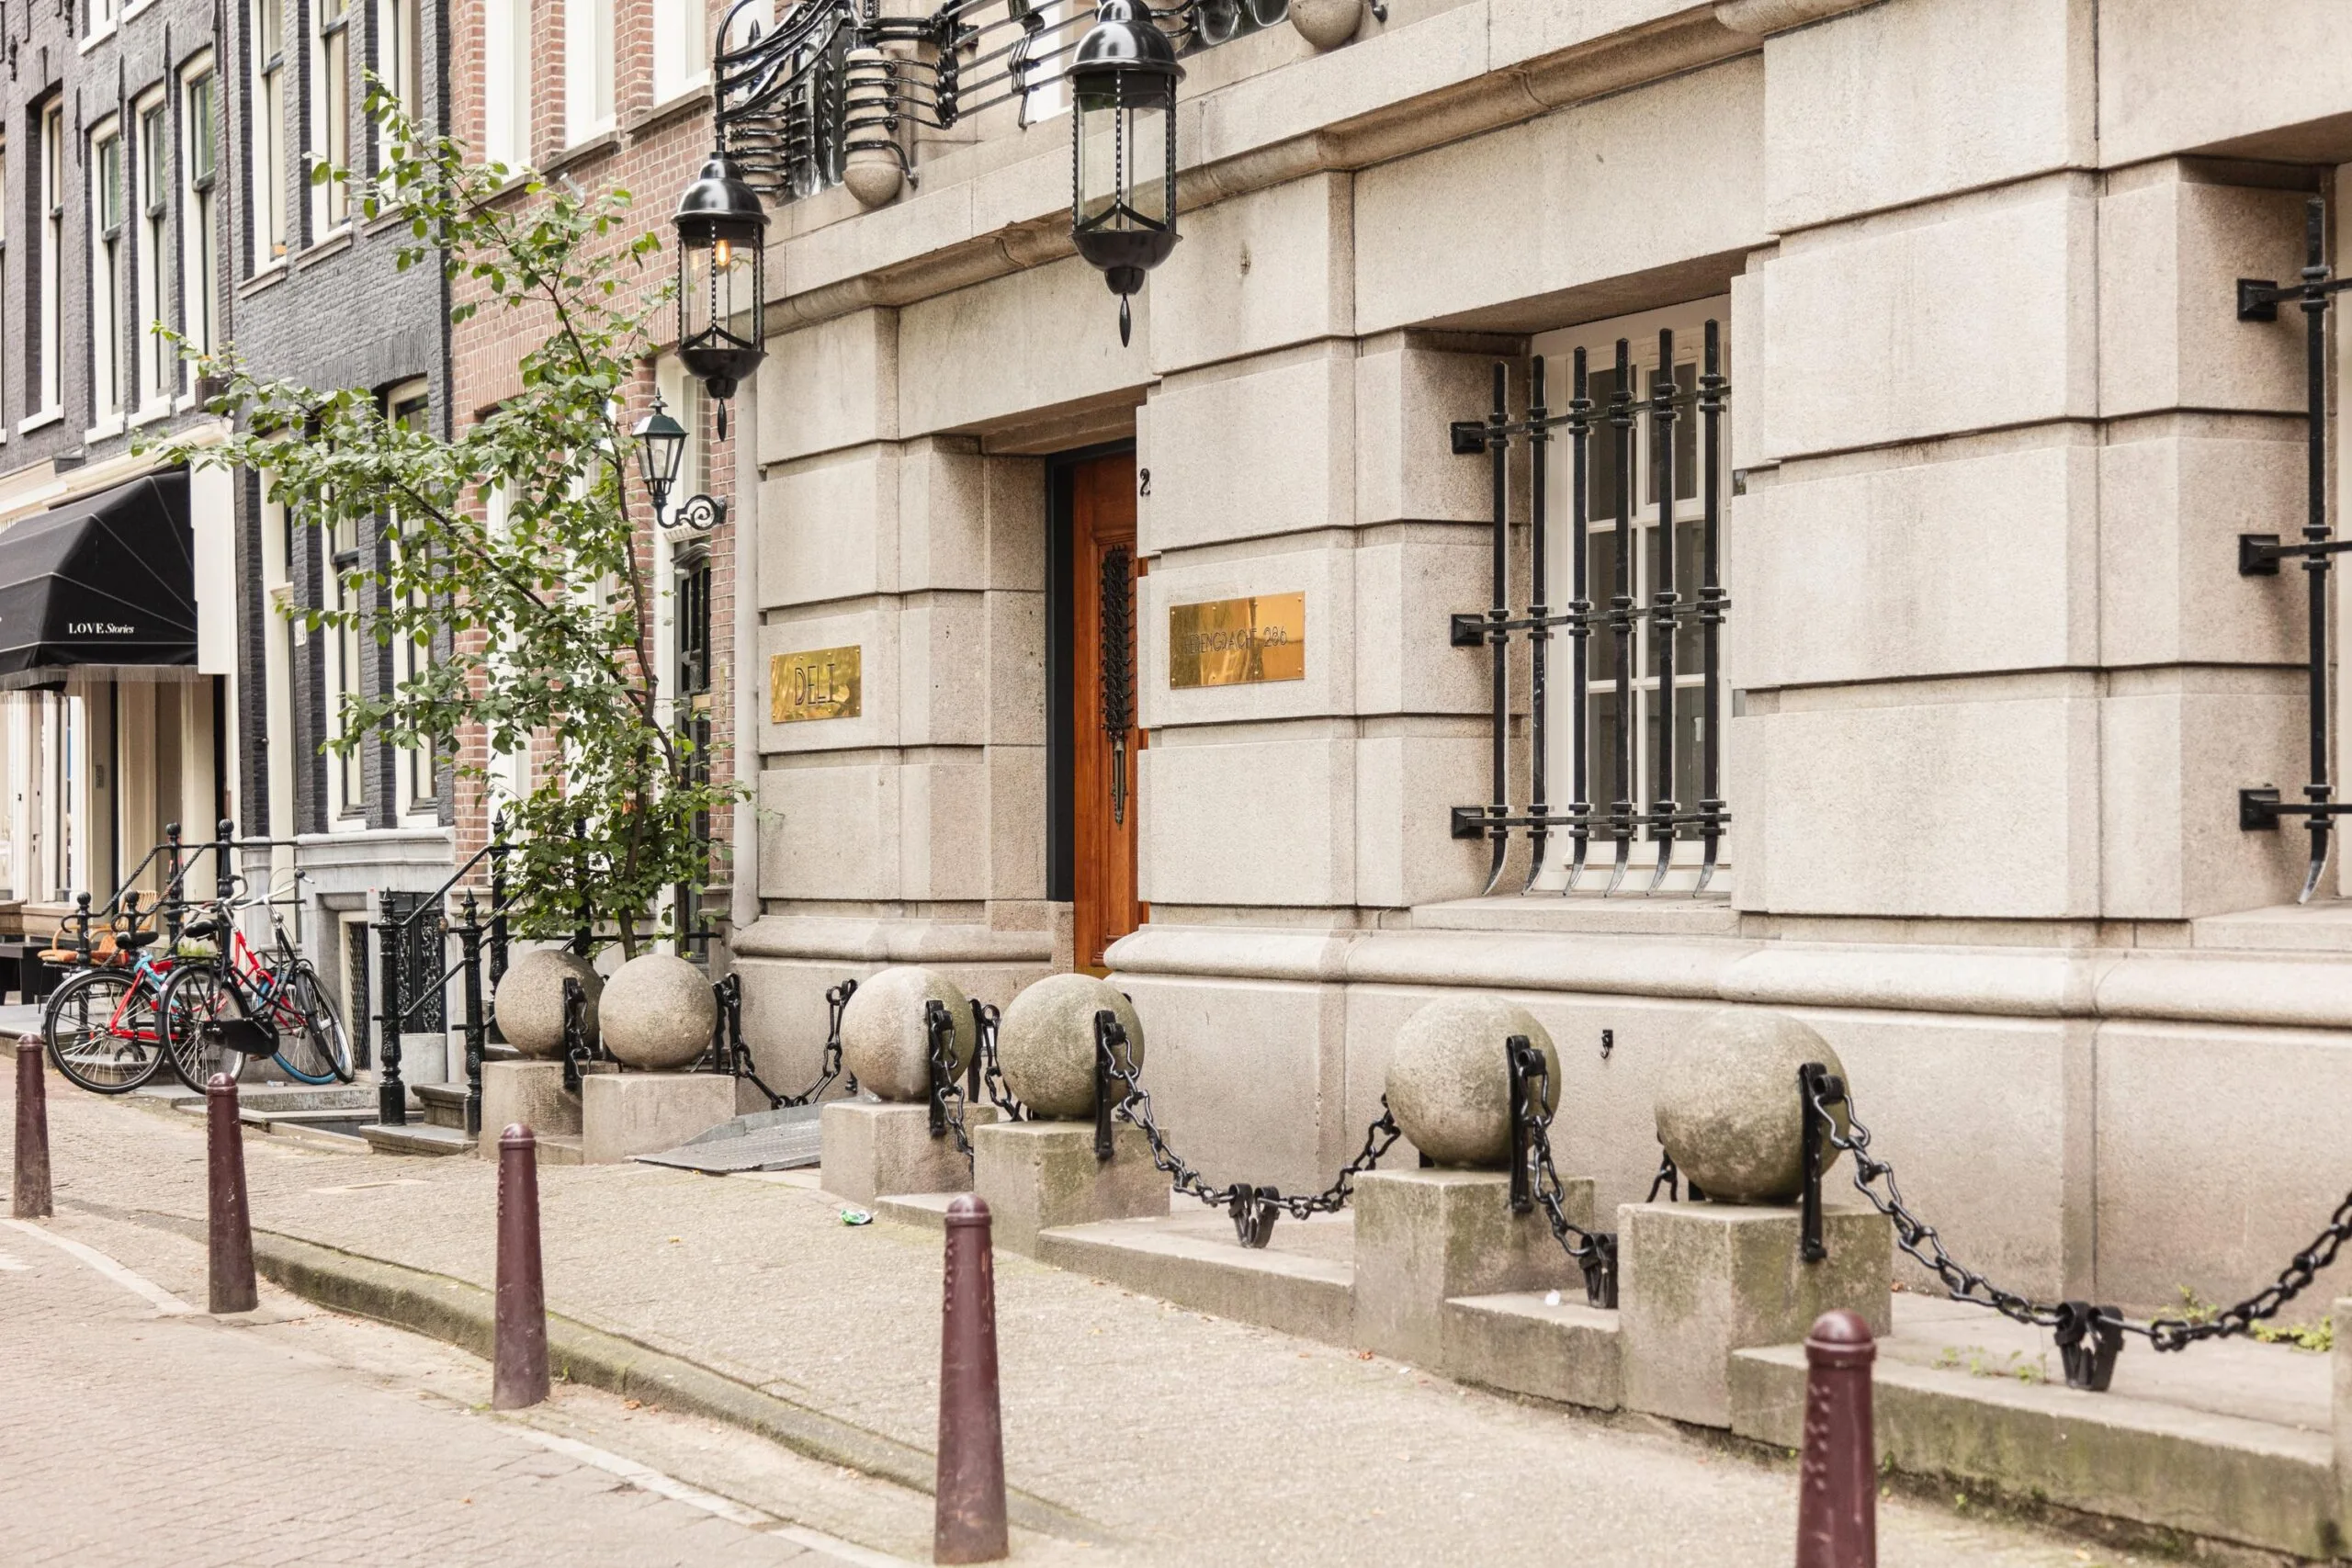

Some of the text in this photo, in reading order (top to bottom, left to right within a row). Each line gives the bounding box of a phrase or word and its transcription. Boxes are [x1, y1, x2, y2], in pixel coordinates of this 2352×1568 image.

[68, 622, 135, 634] LOVE Stories
[1263, 626, 1287, 648] 286
[794, 662, 835, 706] DELI
